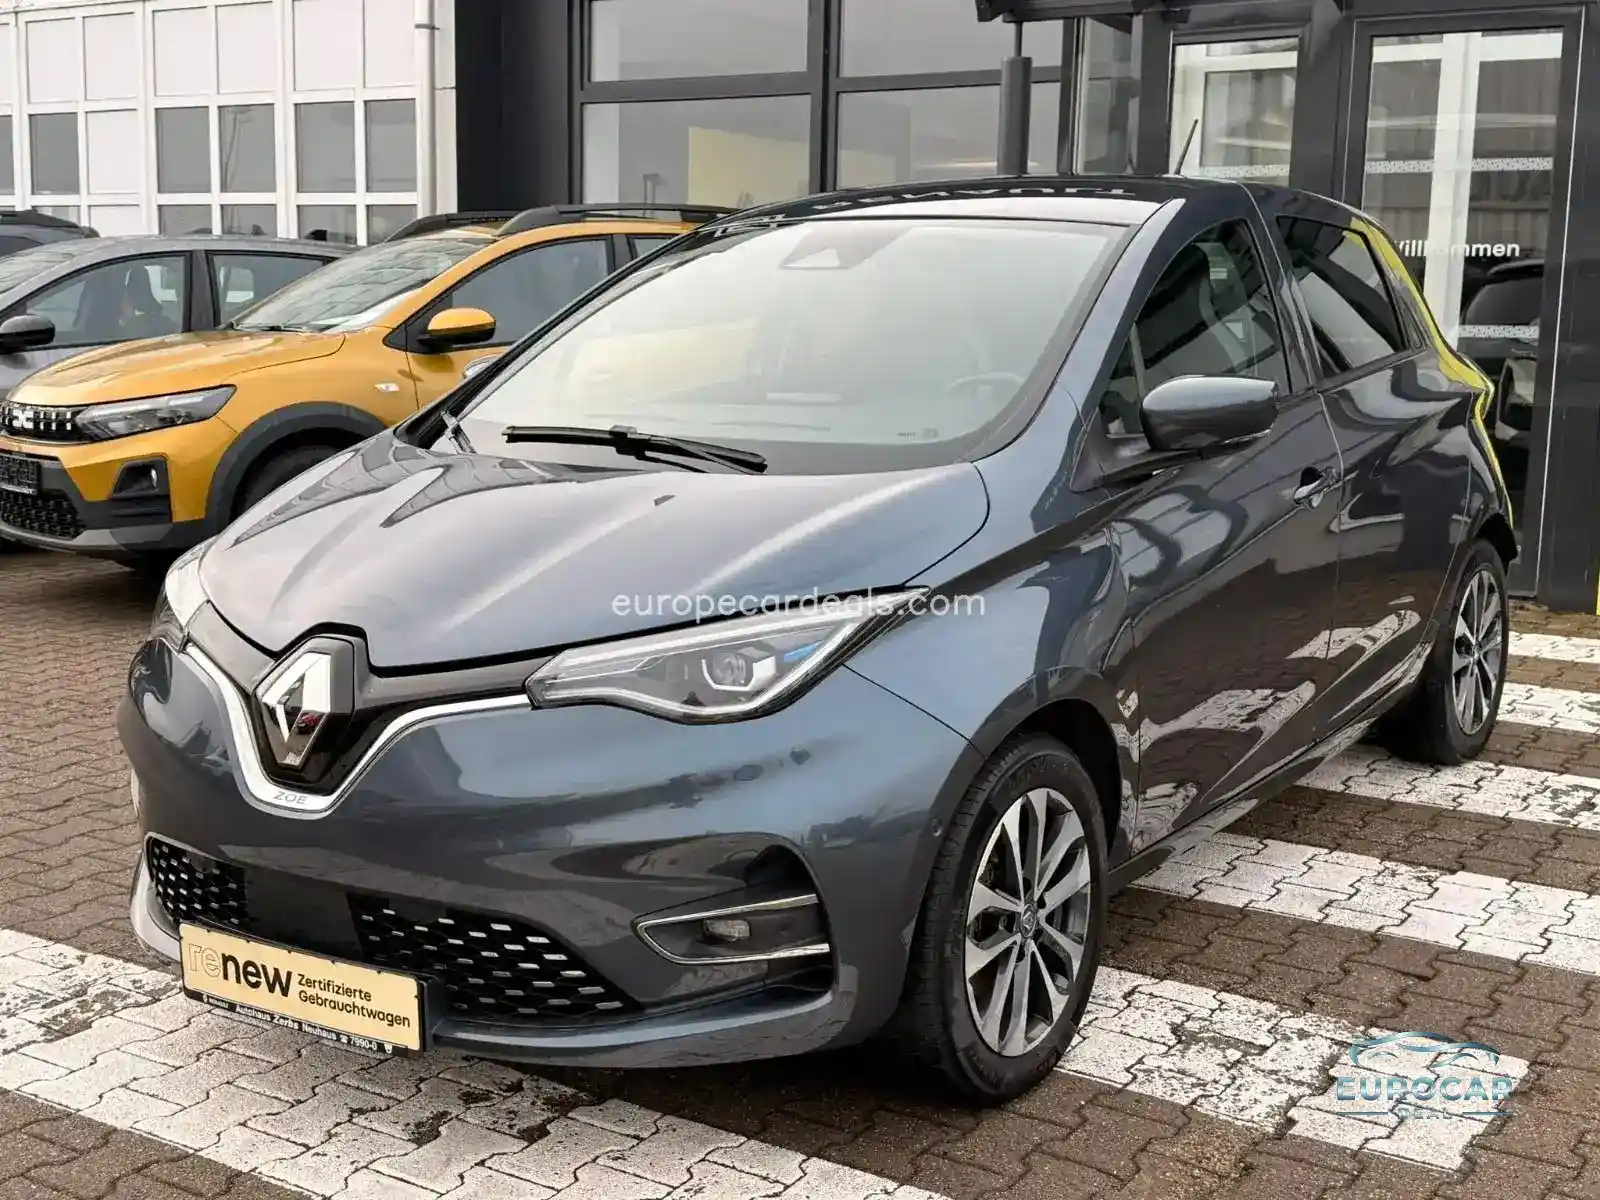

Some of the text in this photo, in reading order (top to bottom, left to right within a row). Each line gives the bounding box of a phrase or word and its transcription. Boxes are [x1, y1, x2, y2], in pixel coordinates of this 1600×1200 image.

[273, 790, 308, 805] ZOE
[188, 944, 293, 997] renew
[297, 973, 372, 1002] Zertifizierte
[298, 990, 411, 1027] Gebrauchtwagen
[235, 1004, 378, 1051] Autohaus Zerbs Neuhaus 7990-0
